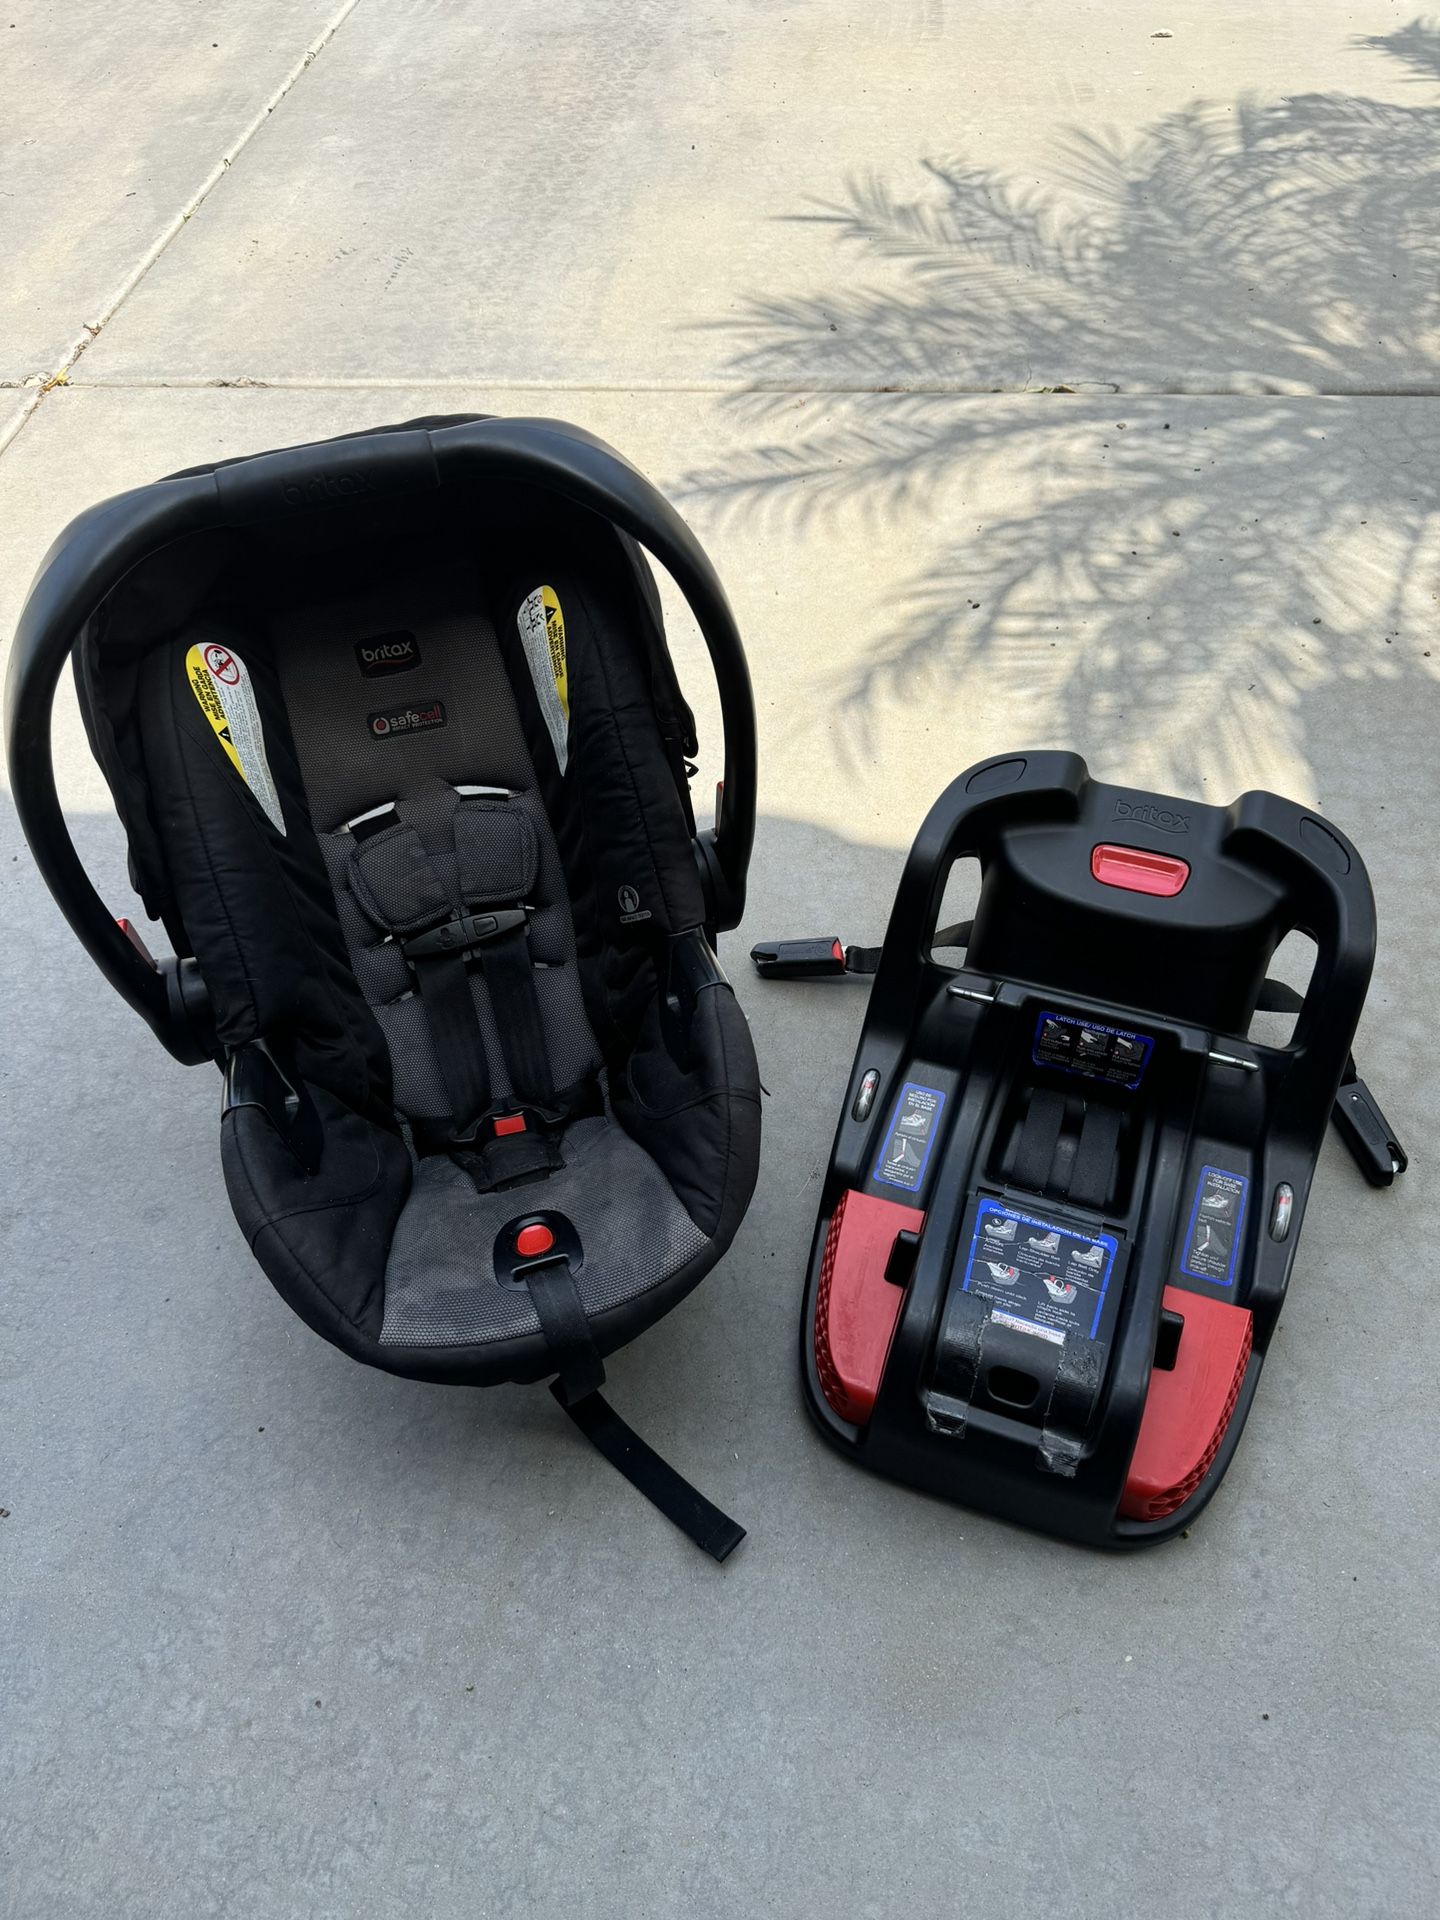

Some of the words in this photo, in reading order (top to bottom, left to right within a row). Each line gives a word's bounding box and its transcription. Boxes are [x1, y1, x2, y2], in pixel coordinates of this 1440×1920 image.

[362, 641, 414, 662] britax
[193, 666, 208, 690] GARDE
[192, 679, 210, 712] WARNING
[202, 669, 226, 720] ADVERTENCIA
[205, 692, 213, 702] EN
[209, 704, 221, 720] MISE
[1114, 799, 1192, 830] britax
[1056, 1015, 1076, 1025] LATCH
[1116, 1029, 1136, 1039] LATCH
[989, 1207, 1020, 1220] OPCIONES
